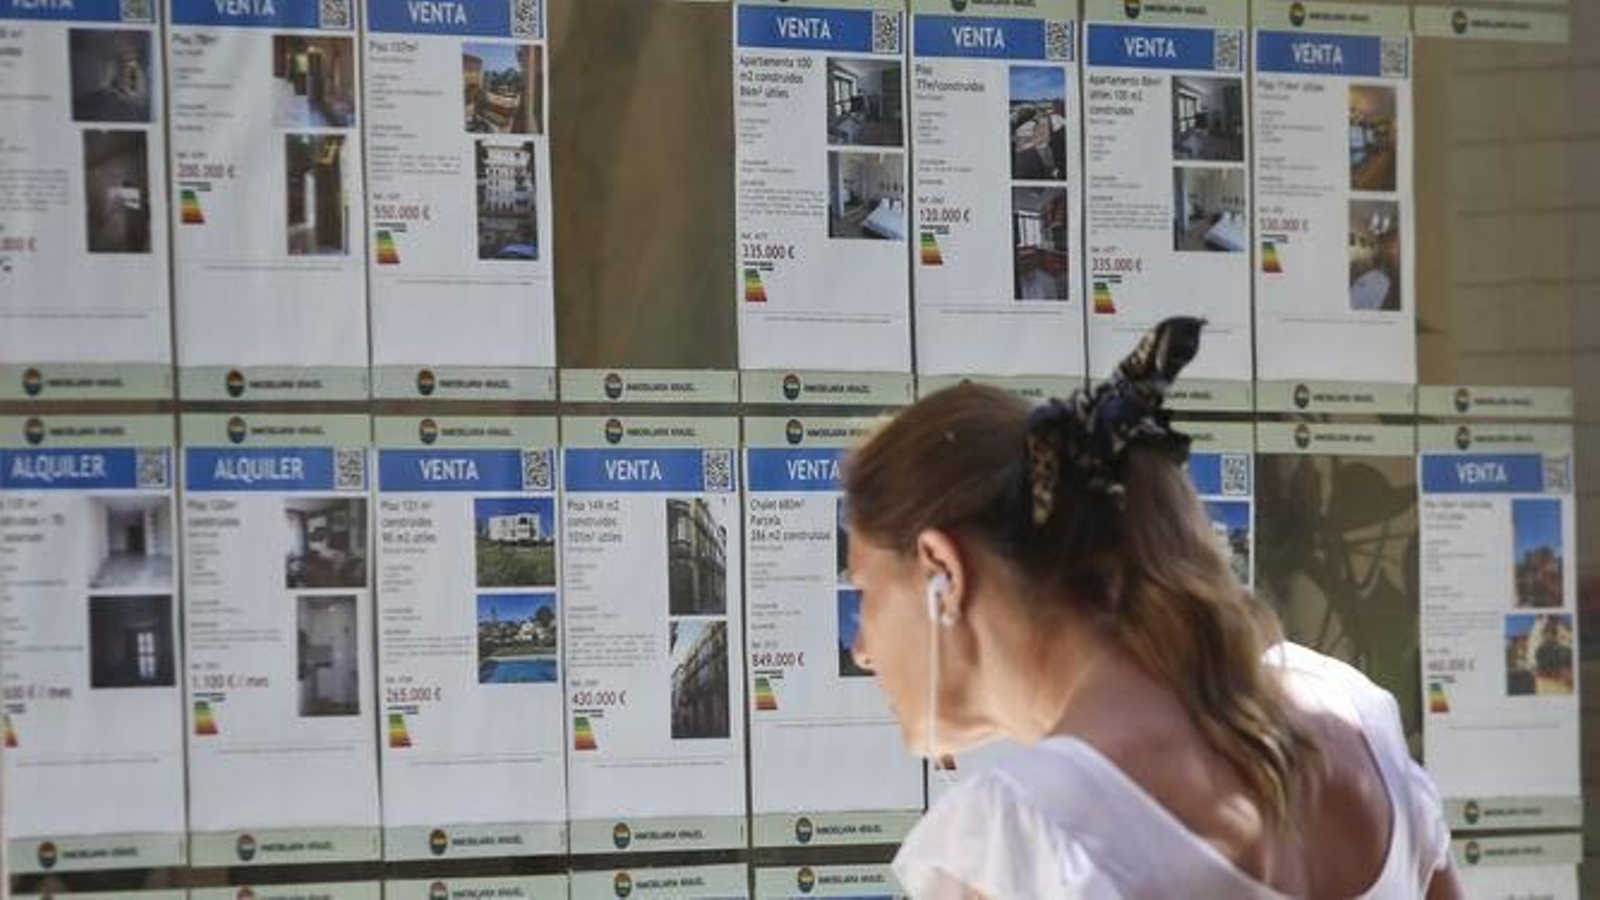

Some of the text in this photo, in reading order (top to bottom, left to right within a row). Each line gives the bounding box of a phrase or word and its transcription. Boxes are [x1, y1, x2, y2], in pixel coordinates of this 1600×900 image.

[214, 0, 275, 17] VENTA
[408, 2, 467, 25] VENTA
[776, 17, 831, 39] VENTA
[953, 26, 1005, 49] VENTA
[1124, 36, 1176, 58] VENTA
[1292, 43, 1343, 65] VENTA
[755, 72, 804, 85] construidos
[963, 208, 971, 223] €
[787, 245, 795, 259] €
[1135, 259, 1143, 273] €
[11, 455, 105, 481] ALQUILER
[214, 457, 304, 484] ALQUILER
[420, 459, 479, 481] VENTA
[605, 459, 662, 481] VENTA
[786, 459, 842, 480] VENTA
[1456, 462, 1507, 483] VENTA
[797, 652, 804, 666] €
[433, 687, 441, 701] €
[572, 690, 627, 706] 430.000 €
